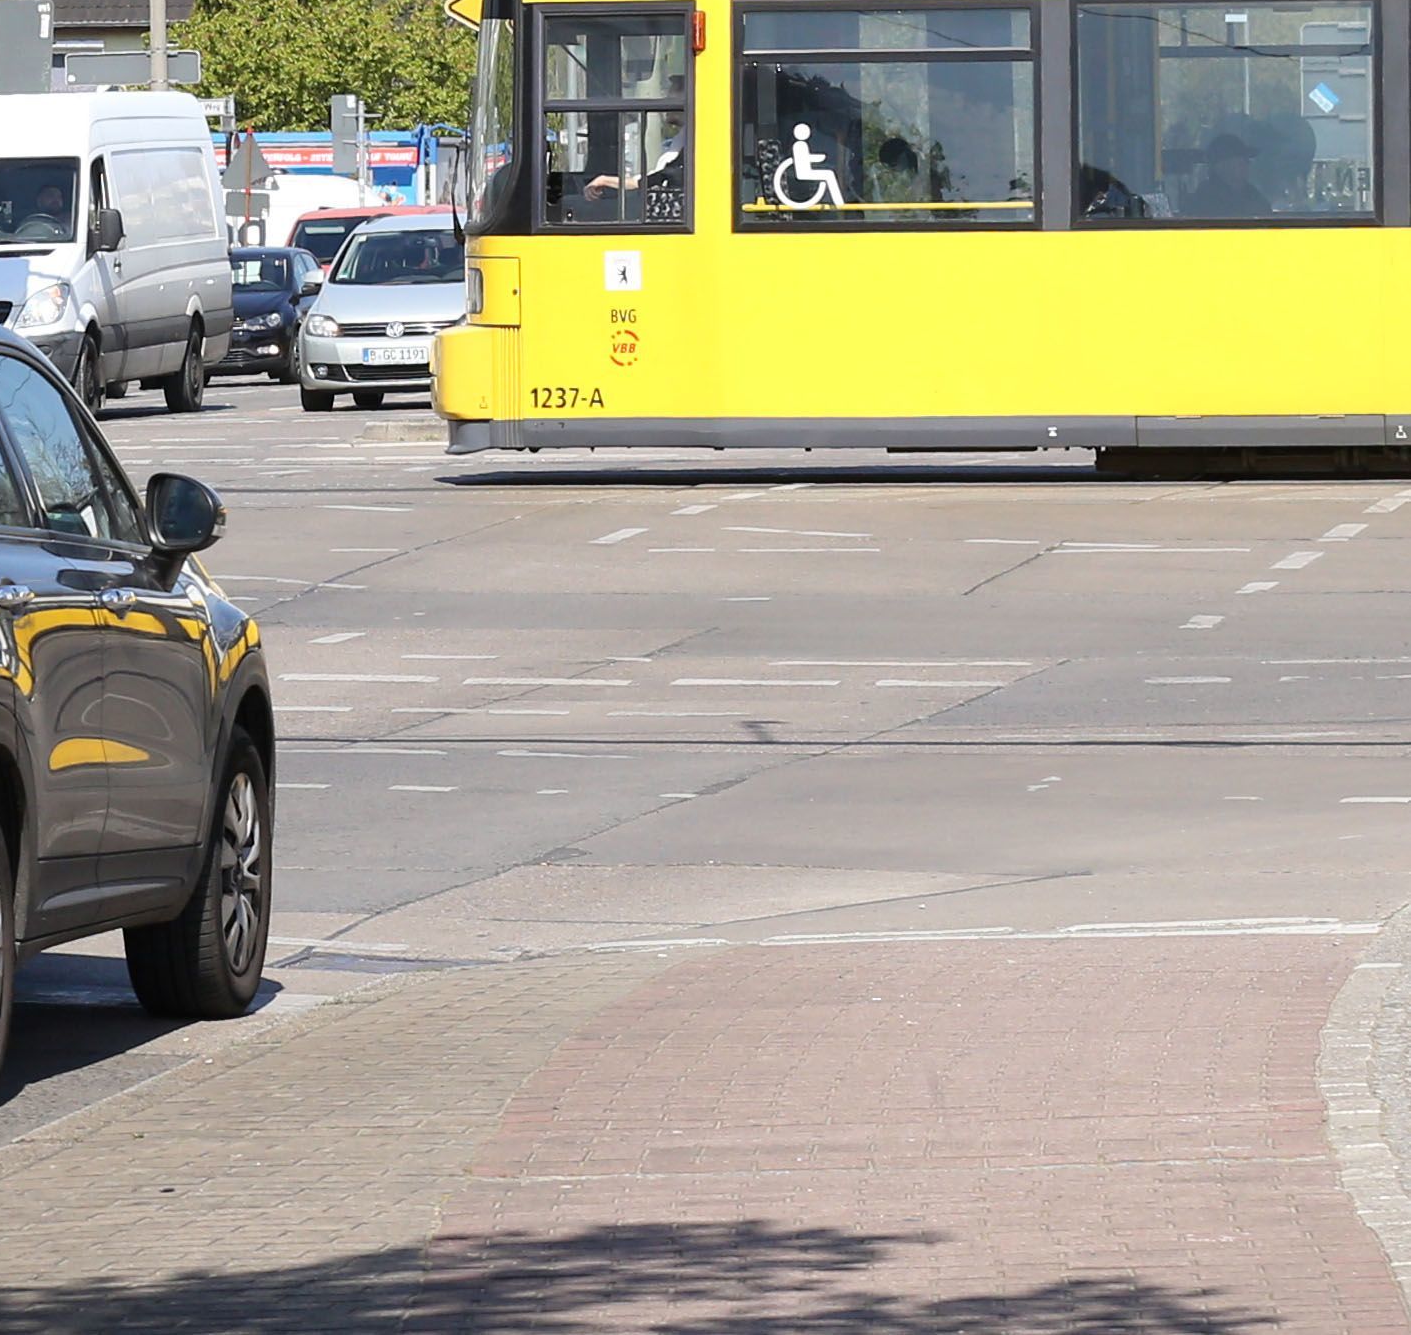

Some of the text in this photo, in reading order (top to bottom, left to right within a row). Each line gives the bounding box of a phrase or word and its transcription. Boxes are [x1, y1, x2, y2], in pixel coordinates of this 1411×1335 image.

[610, 309, 637, 324] BVG
[612, 343, 637, 354] VBB
[530, 387, 605, 409] 1237-A
